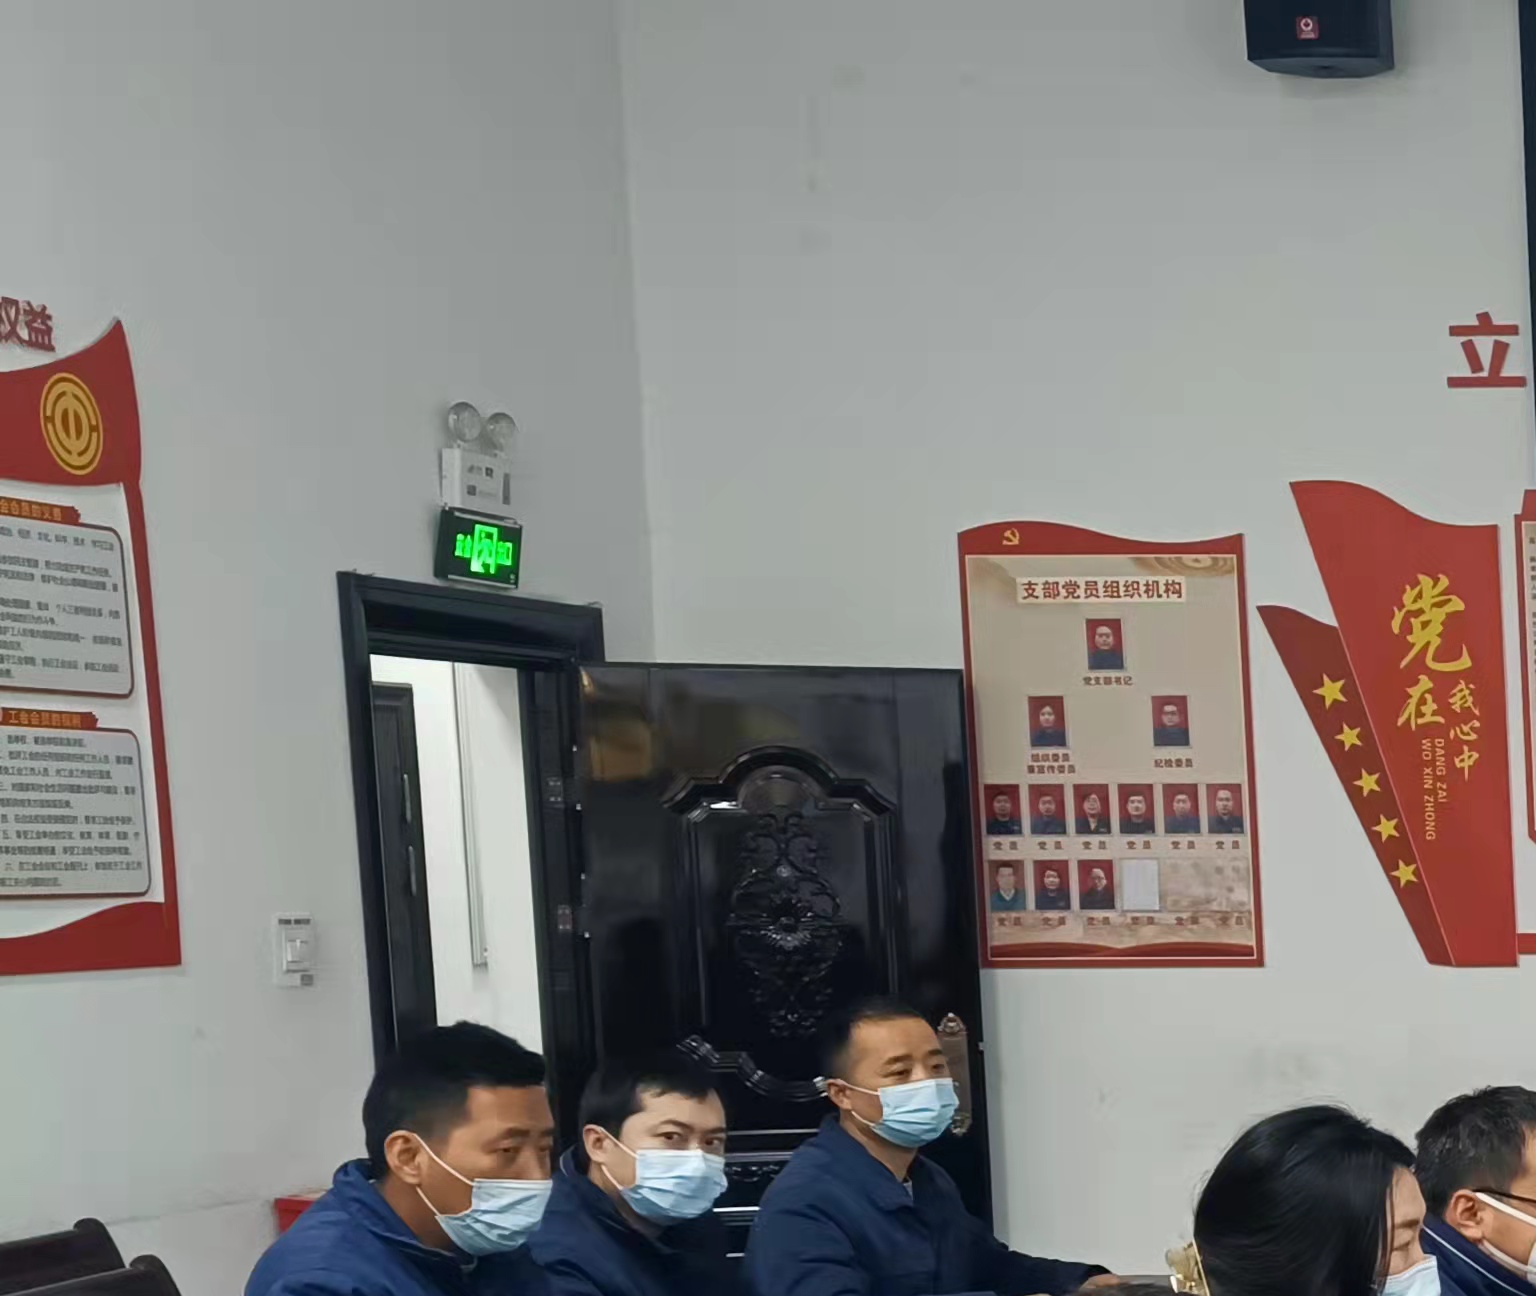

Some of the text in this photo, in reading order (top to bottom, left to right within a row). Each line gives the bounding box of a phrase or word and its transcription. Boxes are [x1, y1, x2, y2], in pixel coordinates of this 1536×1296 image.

[1447, 312, 1527, 388] 立
[1021, 579, 1183, 600] 支部党员组织机构
[1421, 738, 1436, 841] WO XIN ZHONG
[1435, 738, 1448, 803] DANG ZAI
